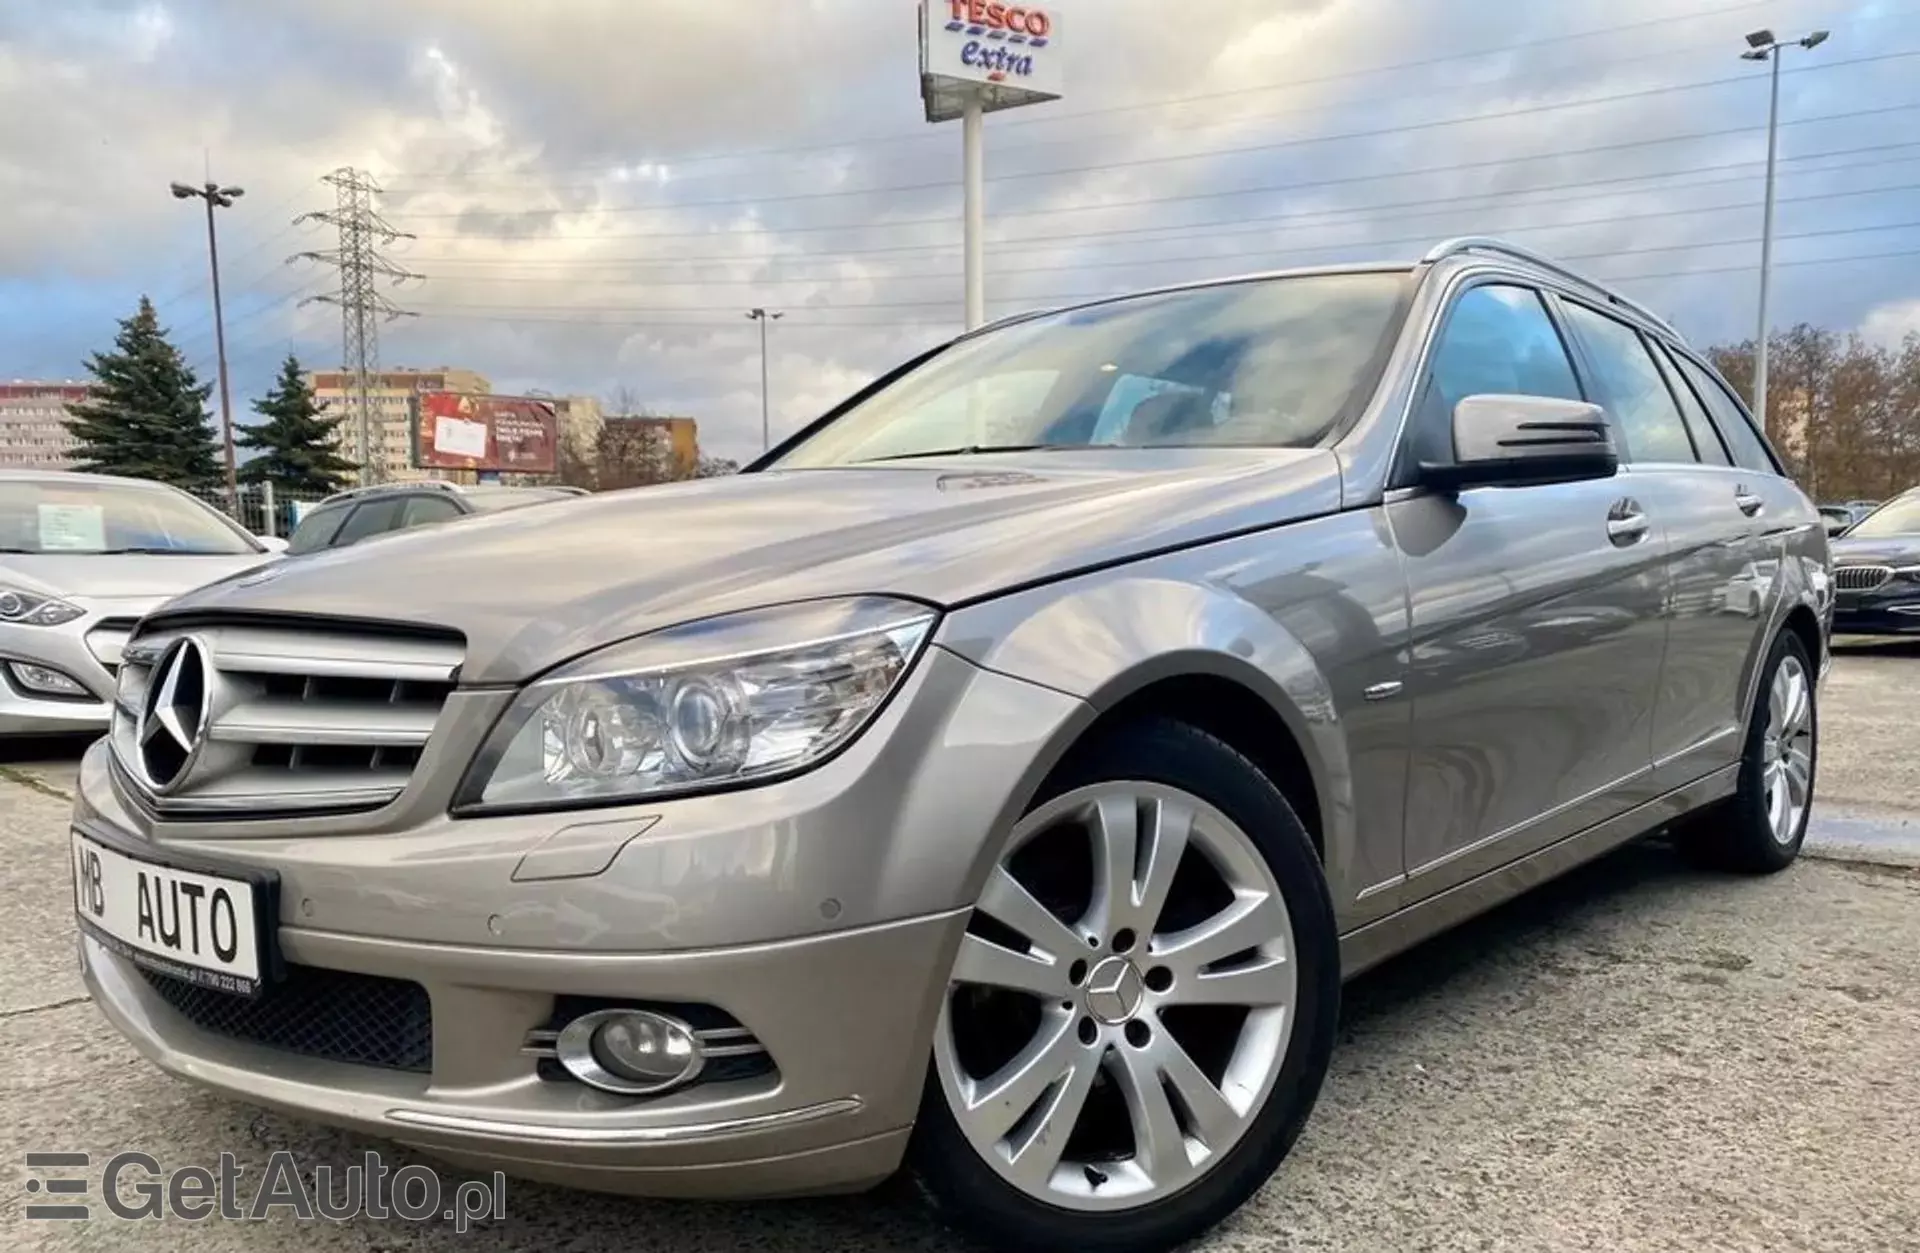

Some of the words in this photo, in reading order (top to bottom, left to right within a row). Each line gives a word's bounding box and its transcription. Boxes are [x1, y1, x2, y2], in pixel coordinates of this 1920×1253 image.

[945, 0, 1049, 36] TESCO
[960, 40, 1033, 76] extra
[79, 844, 105, 917] MB
[137, 871, 238, 963] AUTO
